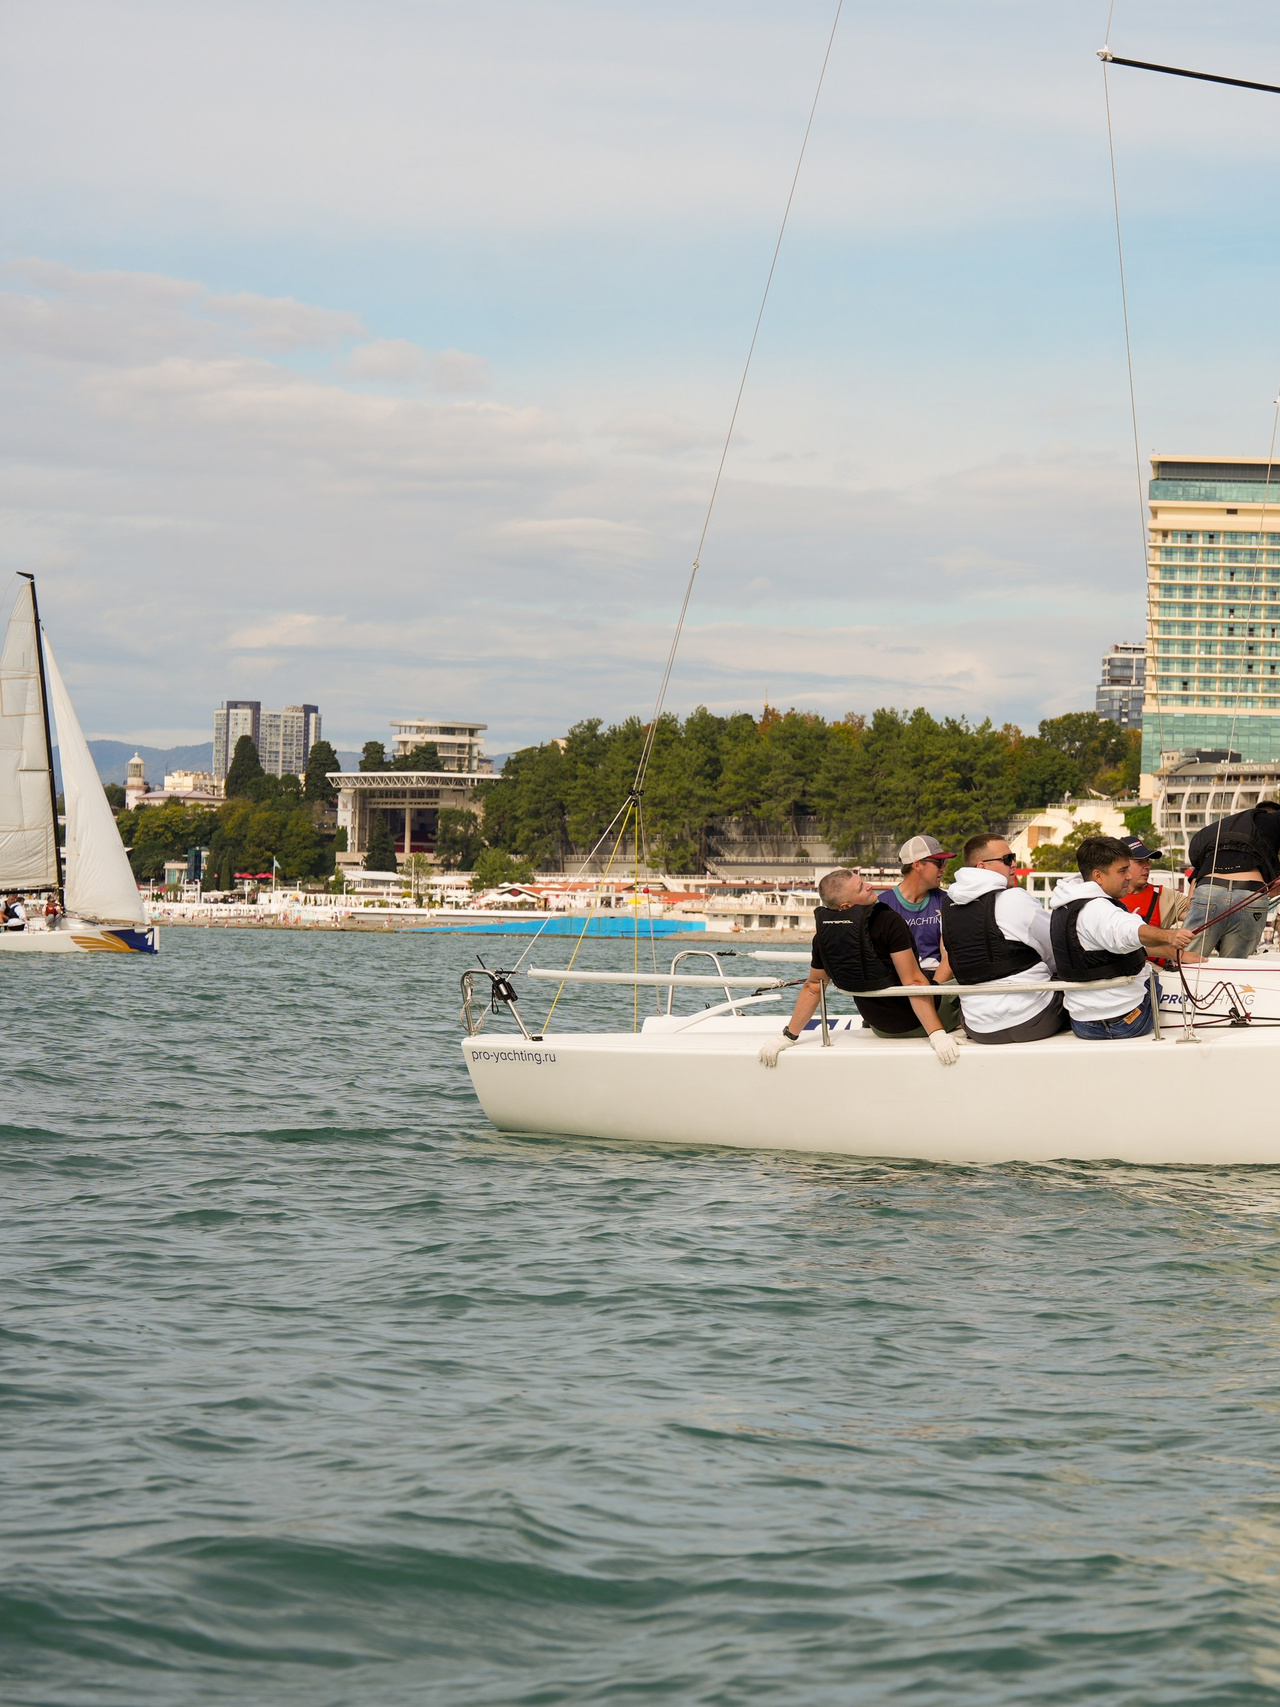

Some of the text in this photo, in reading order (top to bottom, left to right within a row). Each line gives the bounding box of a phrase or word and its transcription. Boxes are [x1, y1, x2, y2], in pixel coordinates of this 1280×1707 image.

[905, 916, 942, 927] YACHTIN
[144, 931, 154, 946] 1
[471, 1050, 557, 1065] pro-yachting.ru
